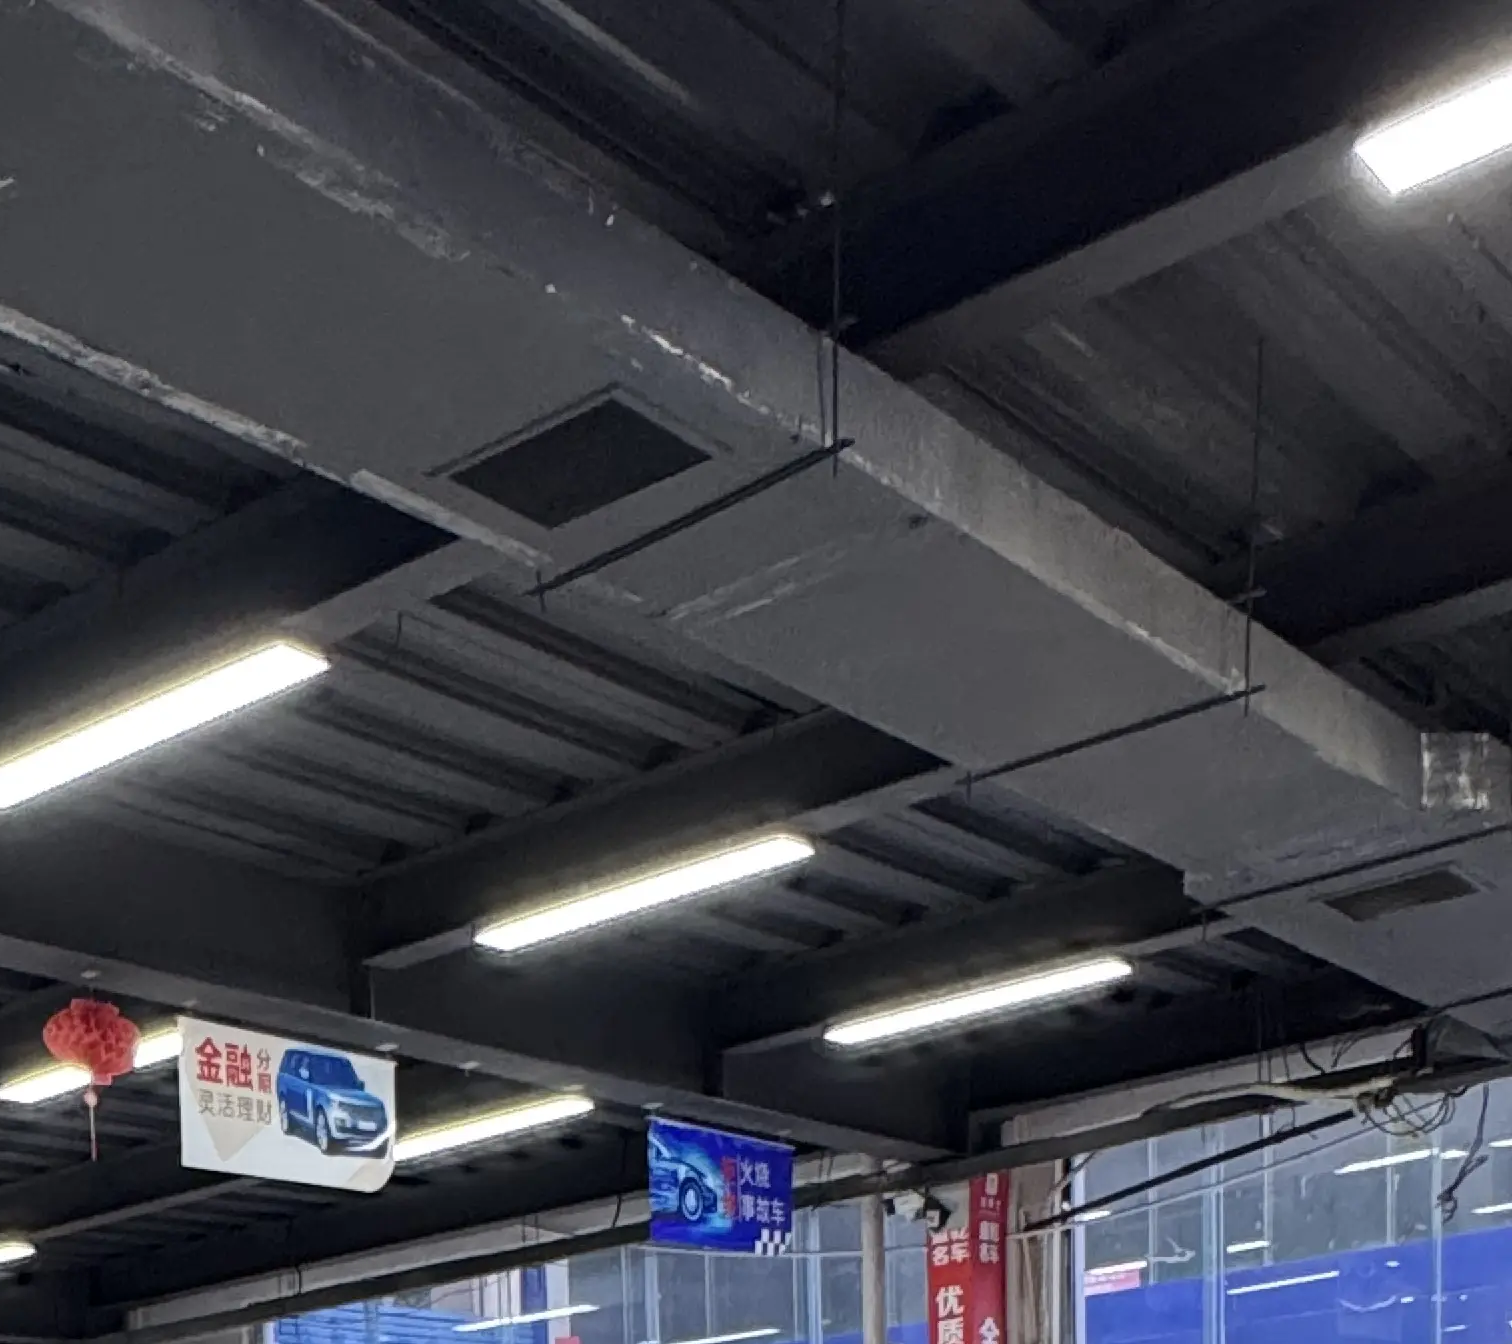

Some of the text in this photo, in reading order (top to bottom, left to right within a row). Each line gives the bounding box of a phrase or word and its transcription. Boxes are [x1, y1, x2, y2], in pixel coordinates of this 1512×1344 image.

[195, 1036, 254, 1091] 金融
[198, 1088, 273, 1126] 灵活理财
